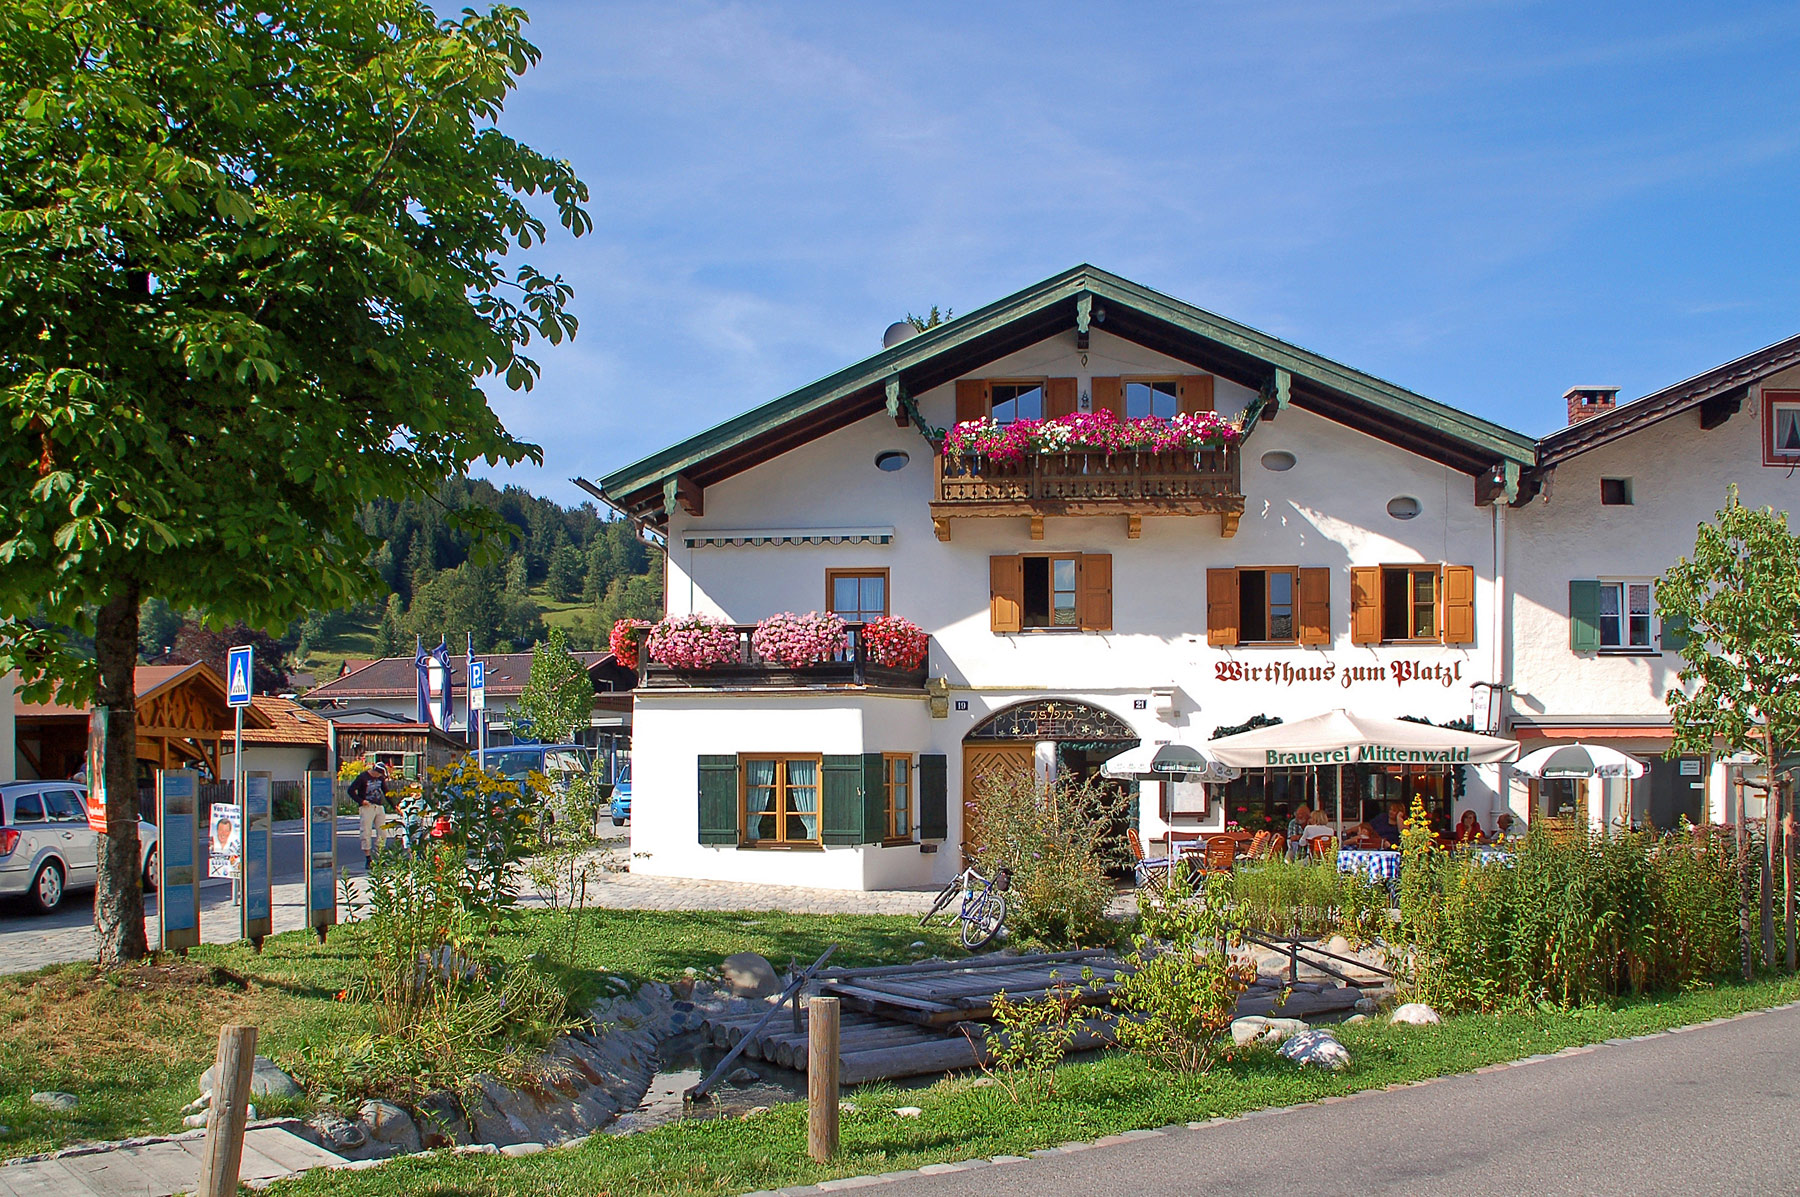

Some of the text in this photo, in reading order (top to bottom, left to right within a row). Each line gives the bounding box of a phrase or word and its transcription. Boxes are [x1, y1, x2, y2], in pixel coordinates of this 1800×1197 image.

[472, 665, 481, 687] P
[1341, 665, 1387, 689] zum
[1390, 659, 1462, 688] Platzl
[1265, 745, 1470, 765] Brauerei Mittenwald
